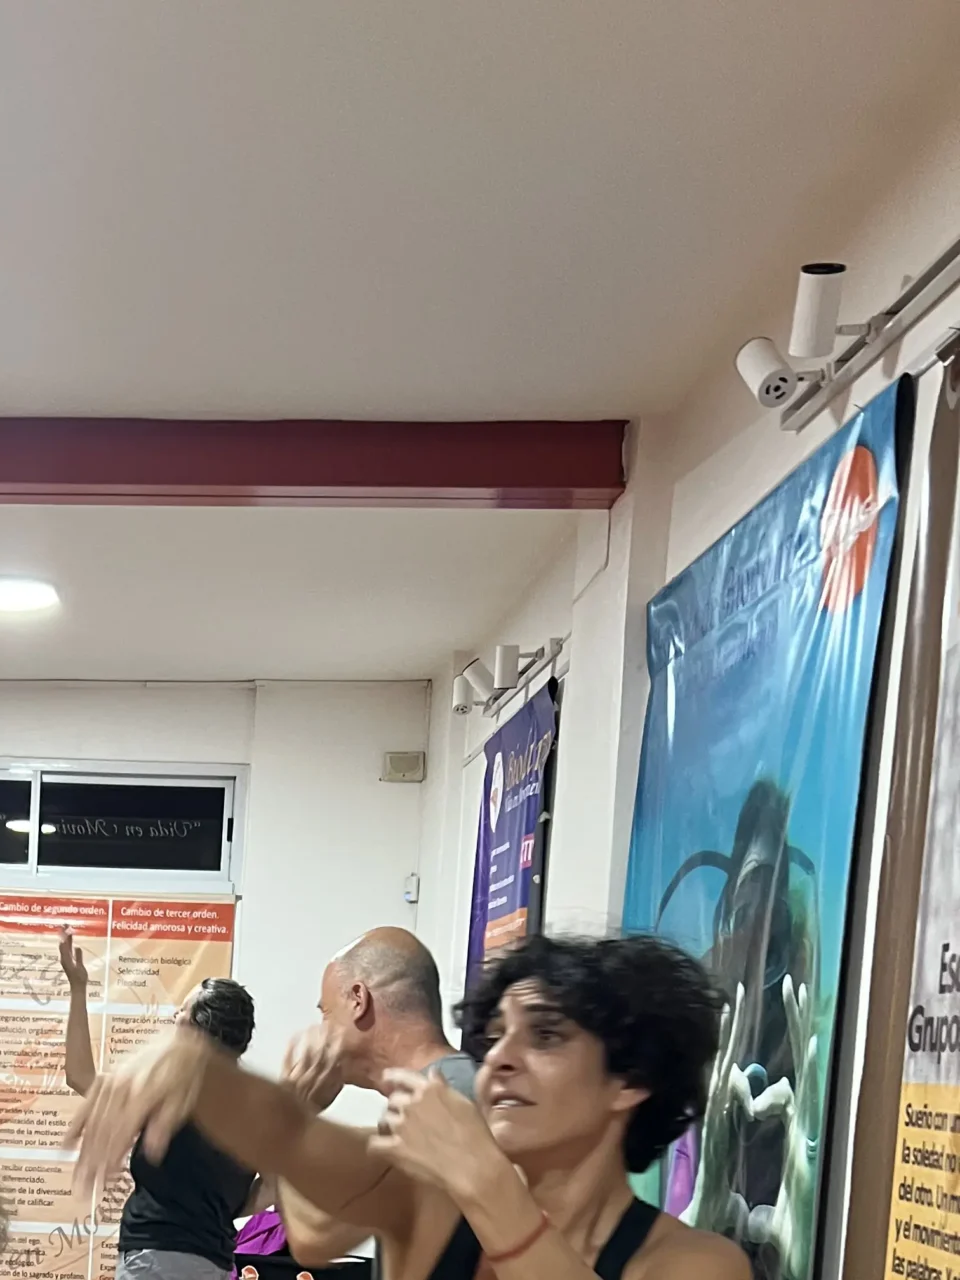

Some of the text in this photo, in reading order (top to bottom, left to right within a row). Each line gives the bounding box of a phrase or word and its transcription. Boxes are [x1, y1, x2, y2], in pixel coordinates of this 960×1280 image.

[31, 902, 42, 913] de
[43, 903, 79, 915] segundo
[120, 907, 220, 920] Cambio de tercer orden.
[112, 920, 230, 936] Felicidad amorosa y creativa.
[118, 955, 159, 965] Renovación
[111, 1016, 176, 1025] Integración afectiv
[110, 1024, 135, 1034] Éxtasis
[110, 1037, 133, 1045] Fusión
[3, 1048, 42, 1058] vinculación
[35, 1088, 70, 1096] capacidad
[24, 1108, 34, 1116] yin
[904, 1103, 948, 1131] Sueño con
[35, 1118, 47, 1126] del
[48, 1119, 67, 1127] estilo
[16, 1127, 25, 1135] de
[26, 1128, 33, 1136] la
[34, 1129, 63, 1137] motivaci
[24, 1139, 37, 1147] por
[38, 1138, 48, 1146] las
[901, 1138, 911, 1164] la
[911, 1140, 944, 1172] soledad
[18, 1187, 27, 1195] de
[28, 1187, 35, 1195] la
[898, 1176, 915, 1201] del
[915, 1183, 934, 1206] otro.
[17, 1197, 26, 1206] de
[895, 1217, 904, 1243] y
[903, 1214, 914, 1240] el
[892, 1248, 905, 1275] las
[12, 1270, 21, 1278] de
[21, 1270, 28, 1278] lo
[29, 1271, 54, 1280] sagrado
[54, 1272, 59, 1280] y
